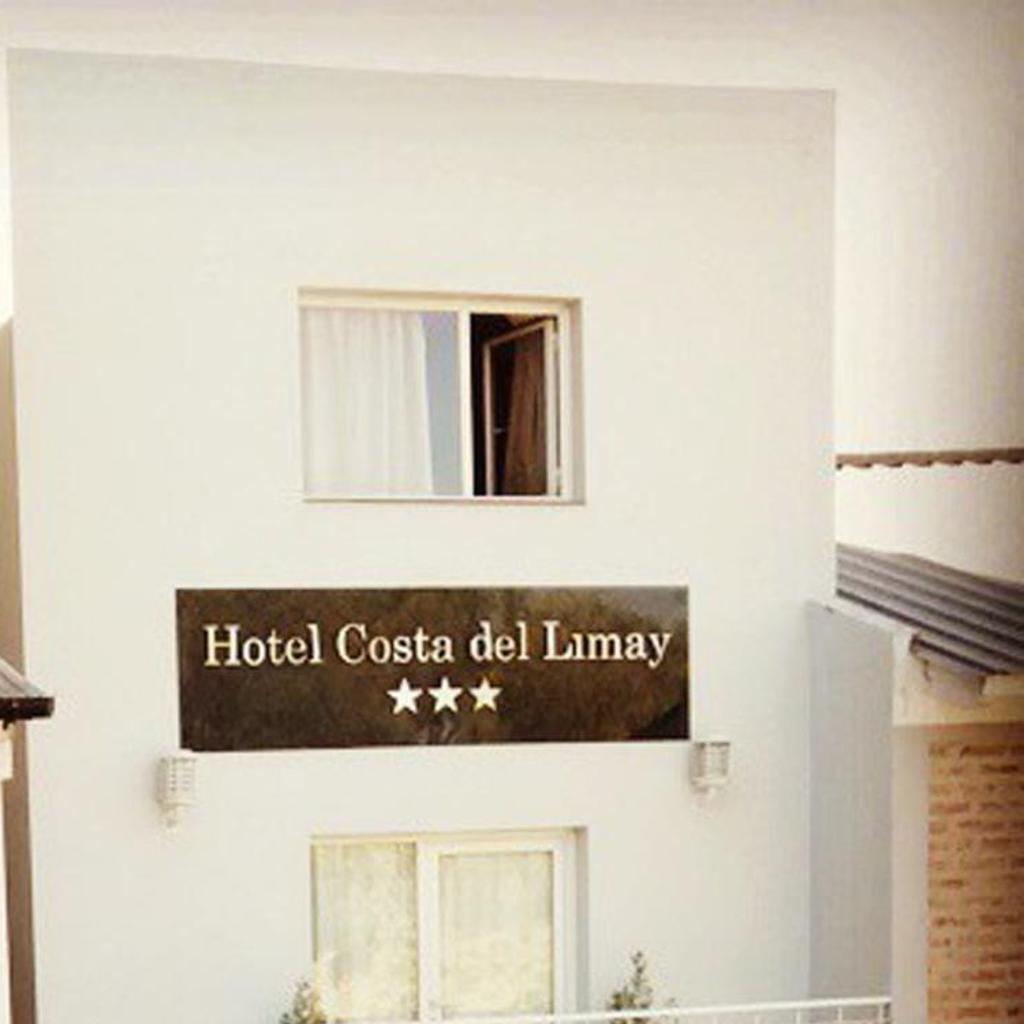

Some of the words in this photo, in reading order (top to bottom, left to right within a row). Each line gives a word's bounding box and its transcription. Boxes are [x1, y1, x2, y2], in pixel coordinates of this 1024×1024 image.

[203, 623, 323, 667] Hotel
[336, 621, 455, 665] Costa
[469, 619, 530, 663] del
